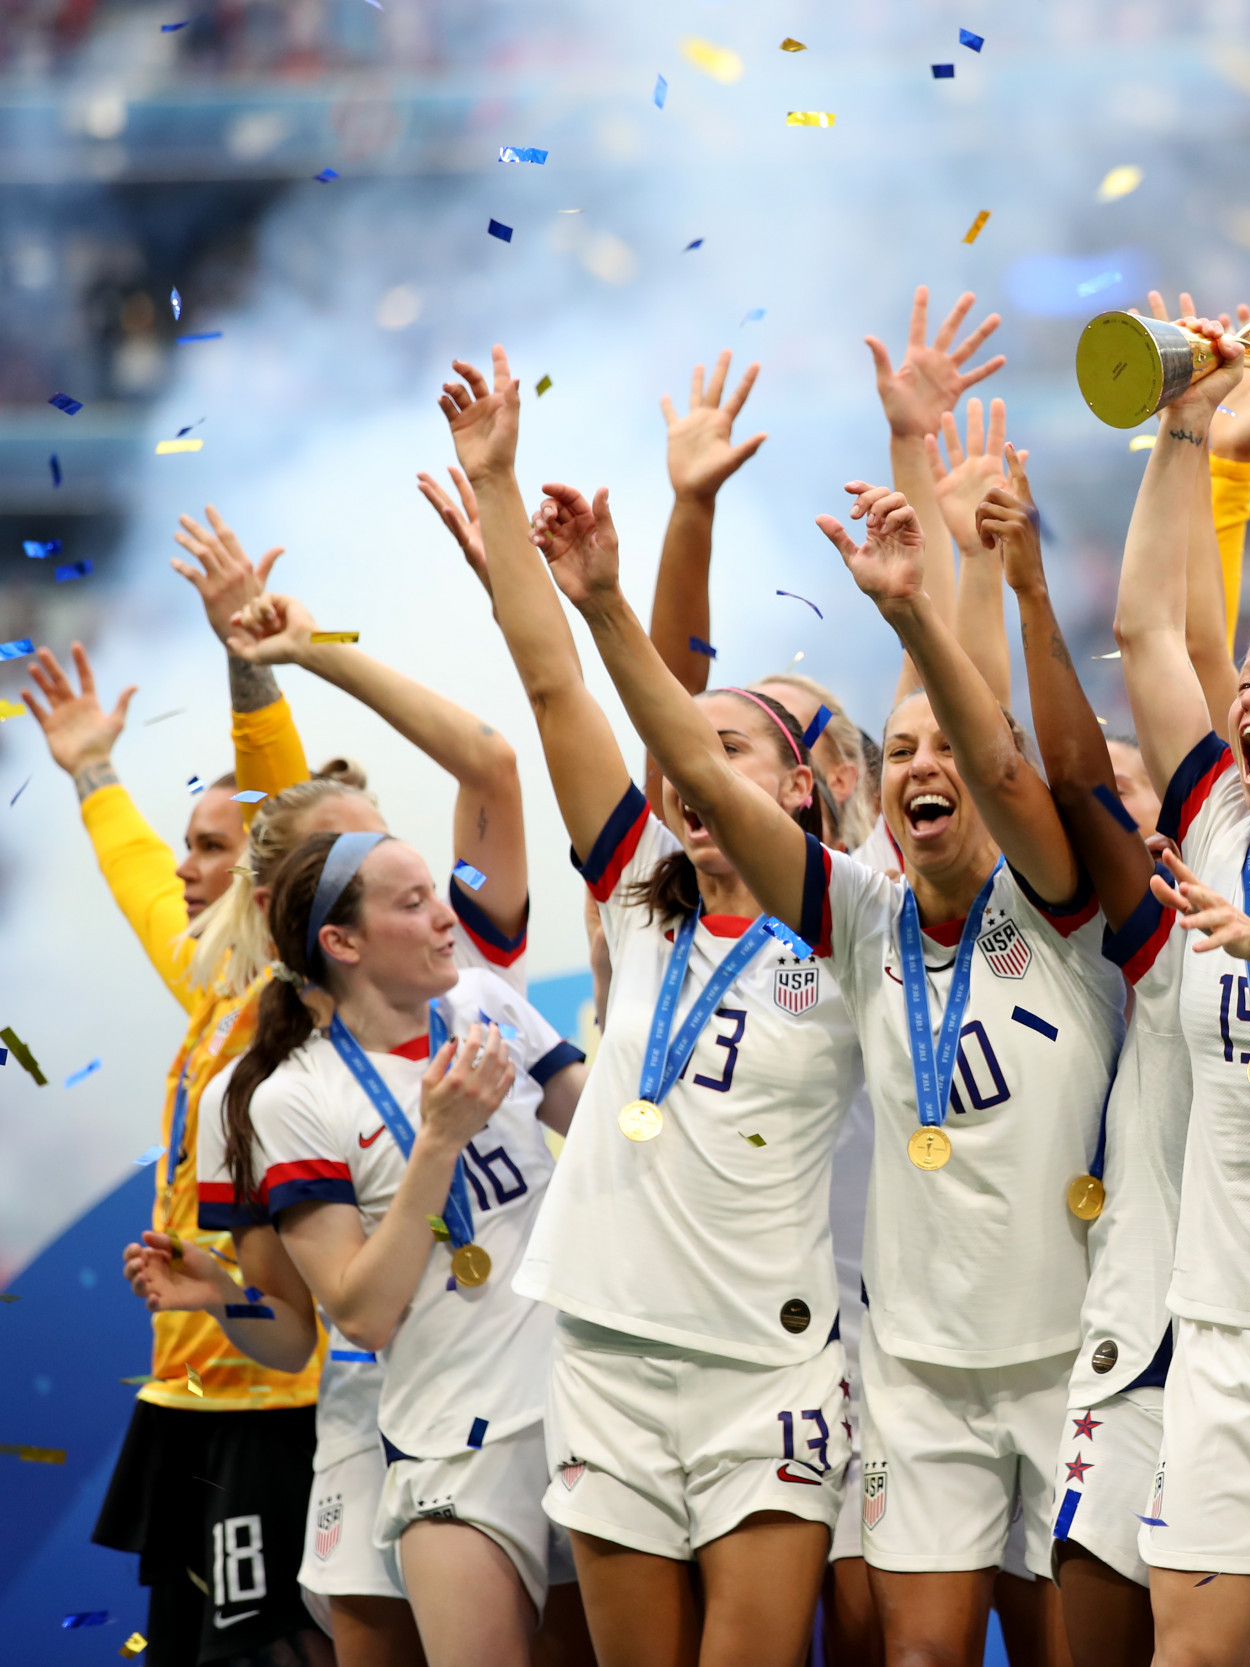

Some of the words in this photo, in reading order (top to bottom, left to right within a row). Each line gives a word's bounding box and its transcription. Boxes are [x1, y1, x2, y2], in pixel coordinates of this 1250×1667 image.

[981, 924, 1016, 953] USA
[778, 972, 815, 990] USA
[777, 1409, 831, 1477] 13
[865, 1476, 884, 1497] USA
[213, 1515, 267, 1606] 18
